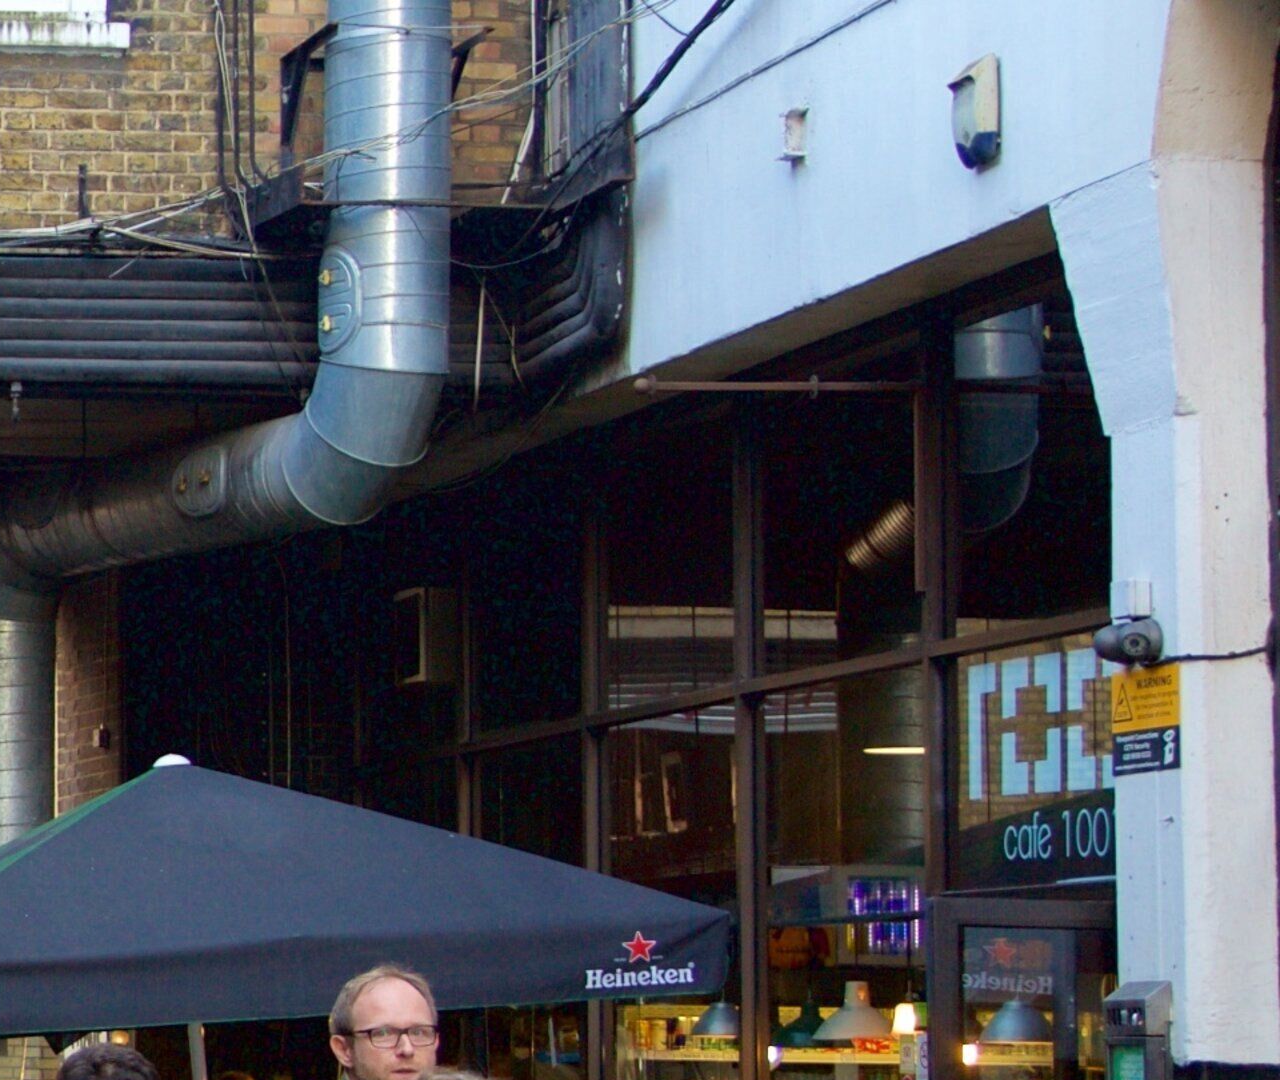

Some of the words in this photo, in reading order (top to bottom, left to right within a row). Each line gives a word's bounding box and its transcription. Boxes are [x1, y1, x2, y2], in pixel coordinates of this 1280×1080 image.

[1003, 810, 1052, 861] cafe
[1062, 807, 1116, 858] 100
[585, 965, 695, 989] Heineken
